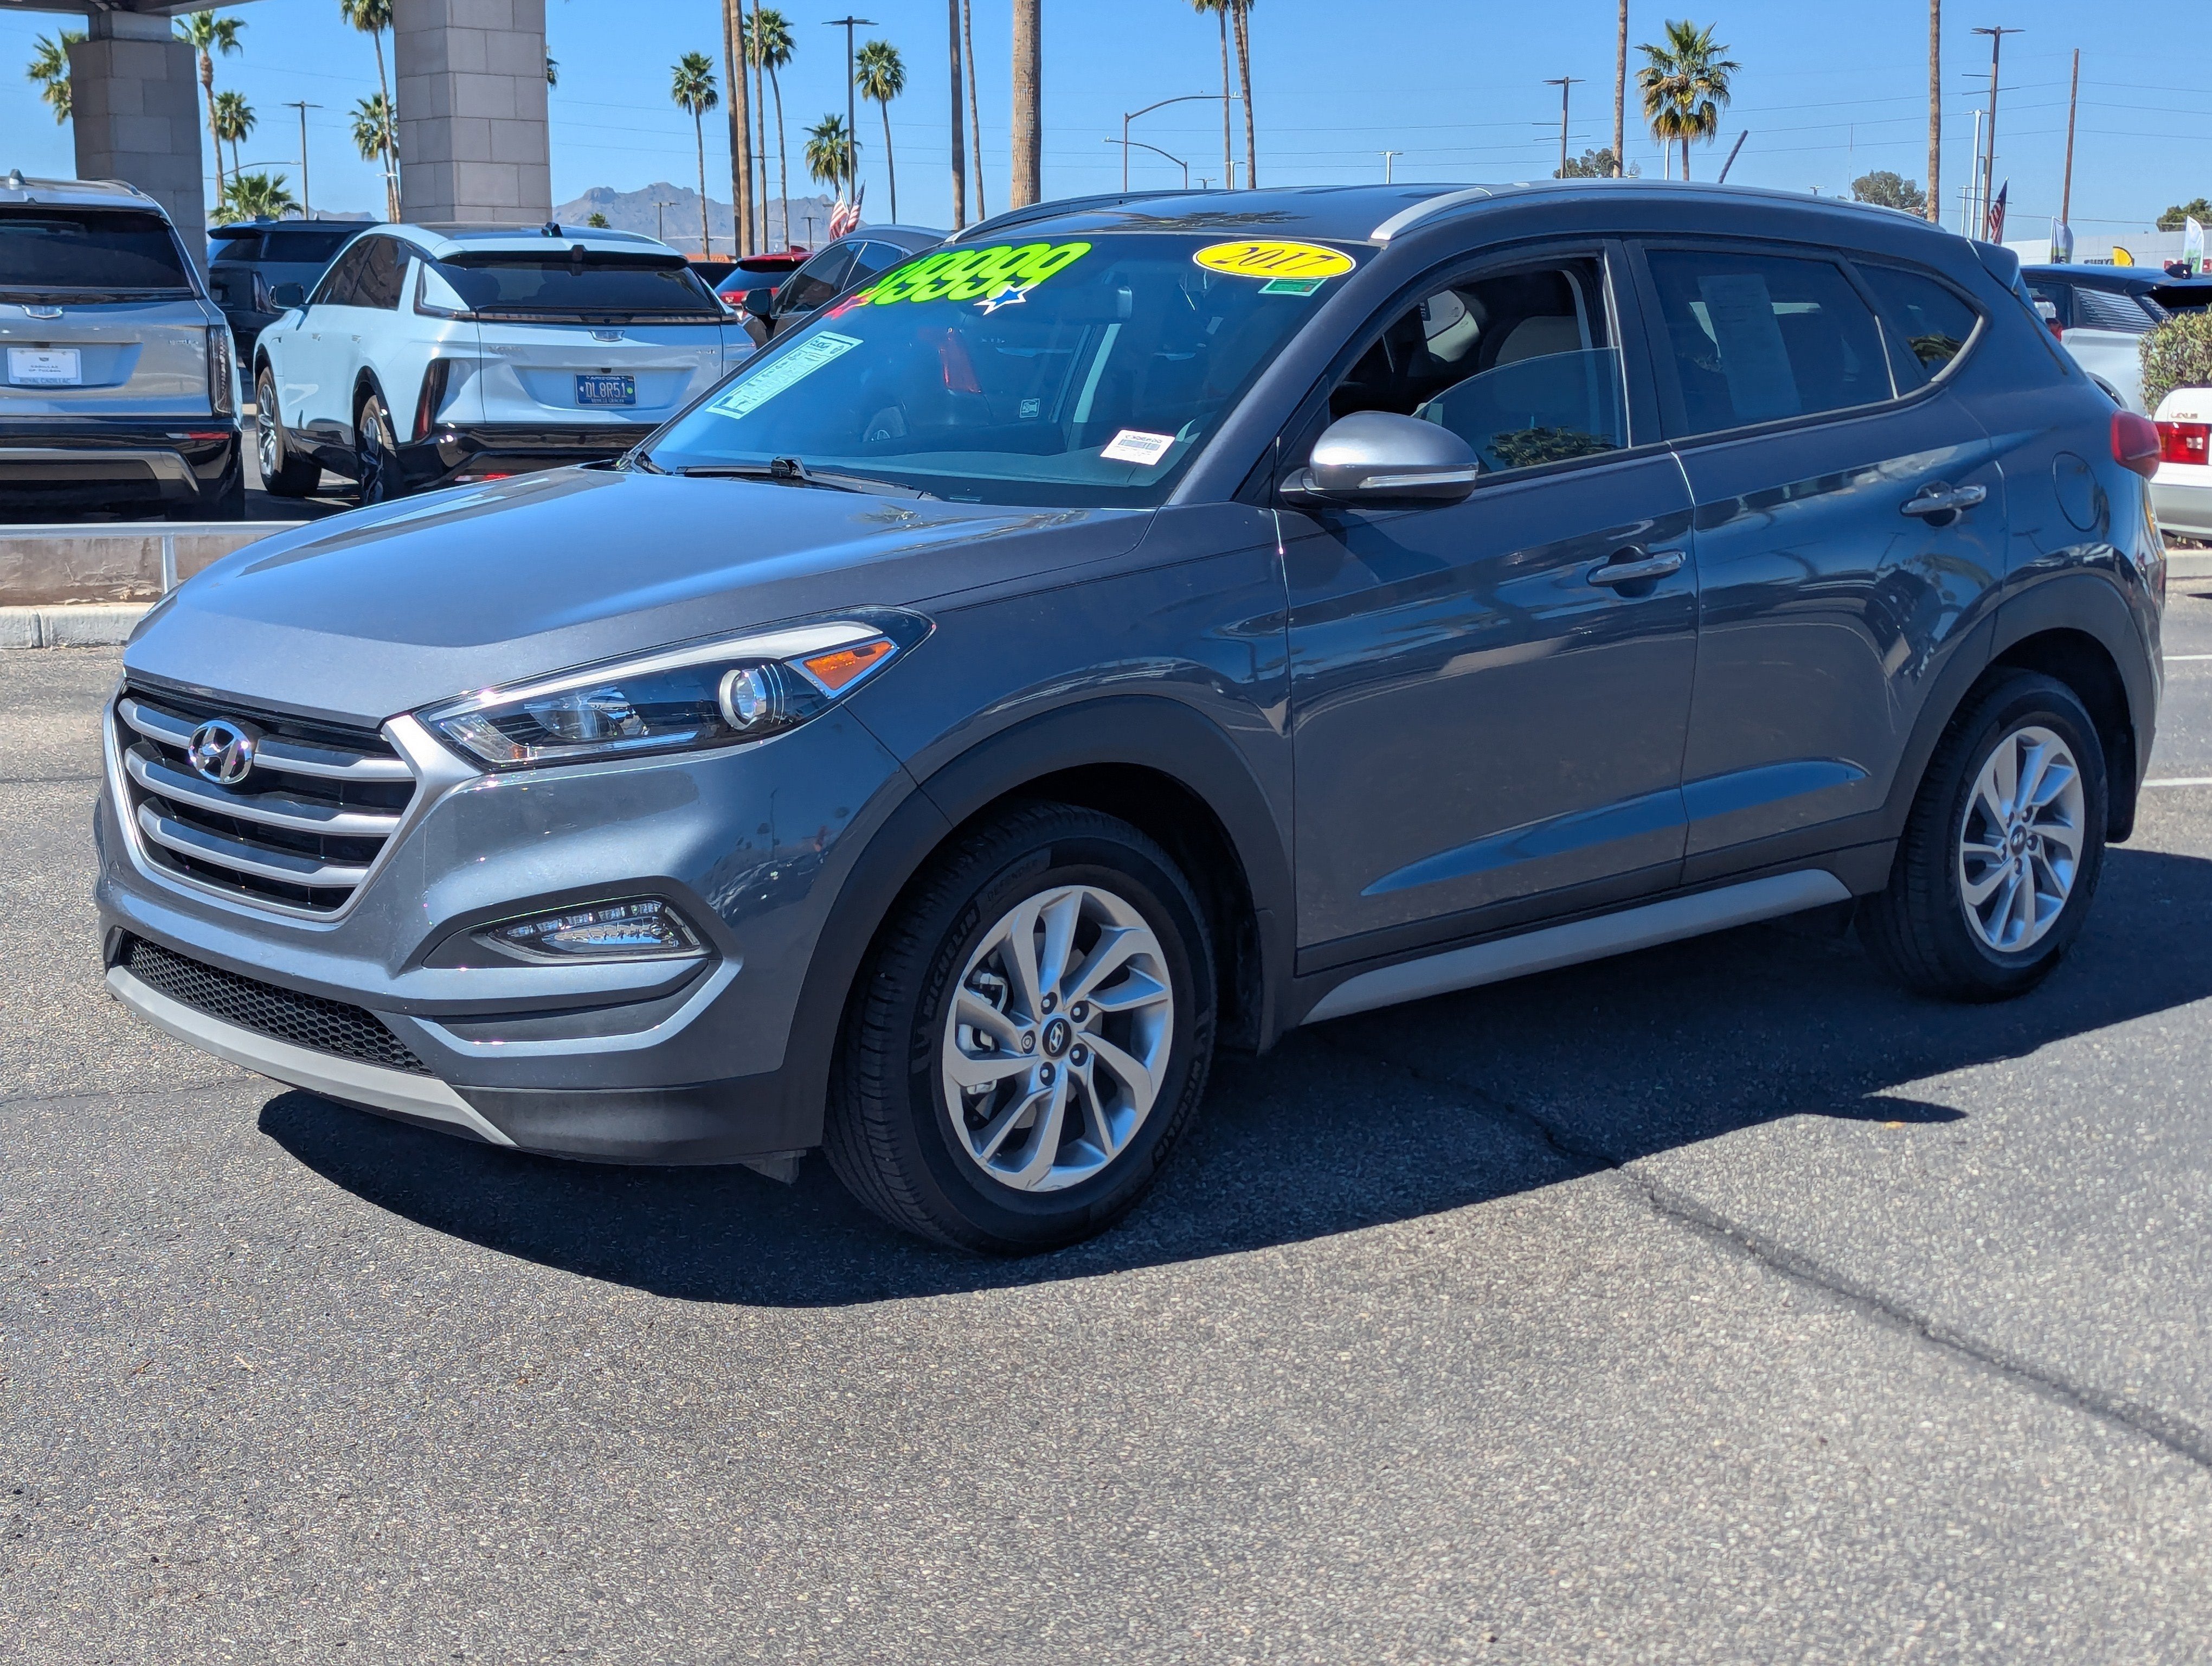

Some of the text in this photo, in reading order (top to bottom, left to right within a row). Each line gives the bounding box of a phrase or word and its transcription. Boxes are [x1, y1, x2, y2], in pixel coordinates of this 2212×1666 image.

[1209, 247, 1340, 271] 2017
[585, 381, 627, 398] DL8R51
[923, 907, 978, 1016] MICHELIN
